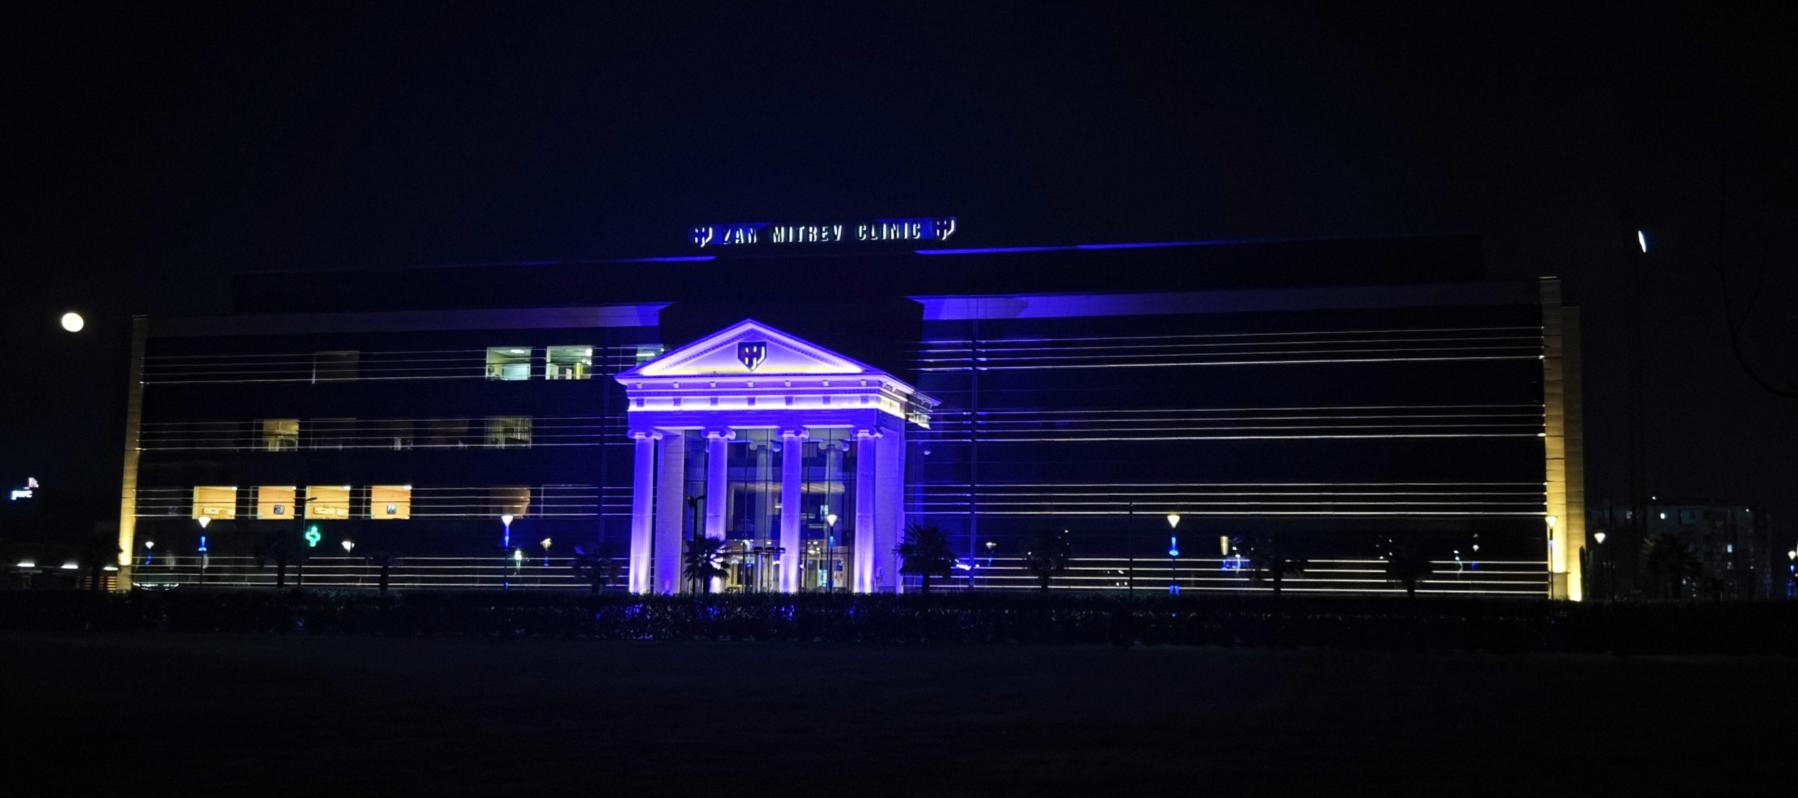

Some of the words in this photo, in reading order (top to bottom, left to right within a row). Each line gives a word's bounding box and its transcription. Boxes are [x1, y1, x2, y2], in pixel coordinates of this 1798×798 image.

[722, 227, 757, 245] ZAN
[772, 225, 843, 243] MITREV
[858, 222, 921, 241] CLINIC
